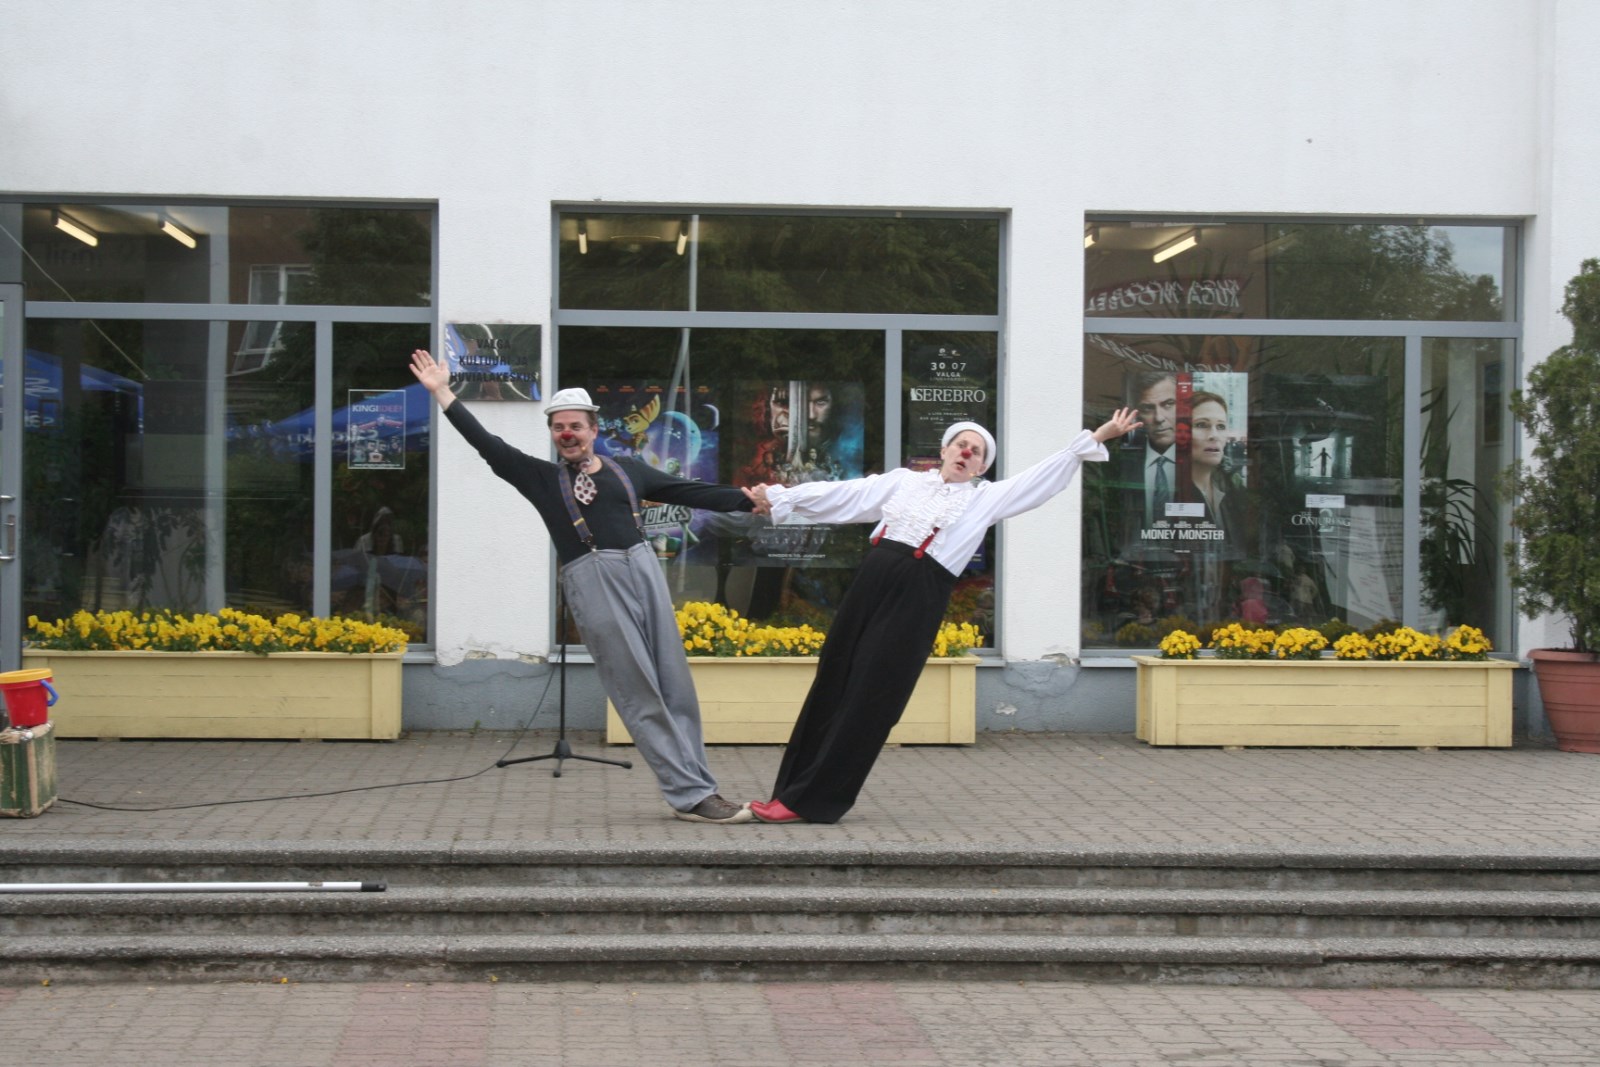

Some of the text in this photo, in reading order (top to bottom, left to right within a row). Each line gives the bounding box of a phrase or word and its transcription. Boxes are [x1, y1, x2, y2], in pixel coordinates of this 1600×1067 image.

[476, 339, 511, 350] VALGA
[915, 387, 986, 403] SEREBRO
[1141, 529, 1225, 540] MONEY MONSTER
